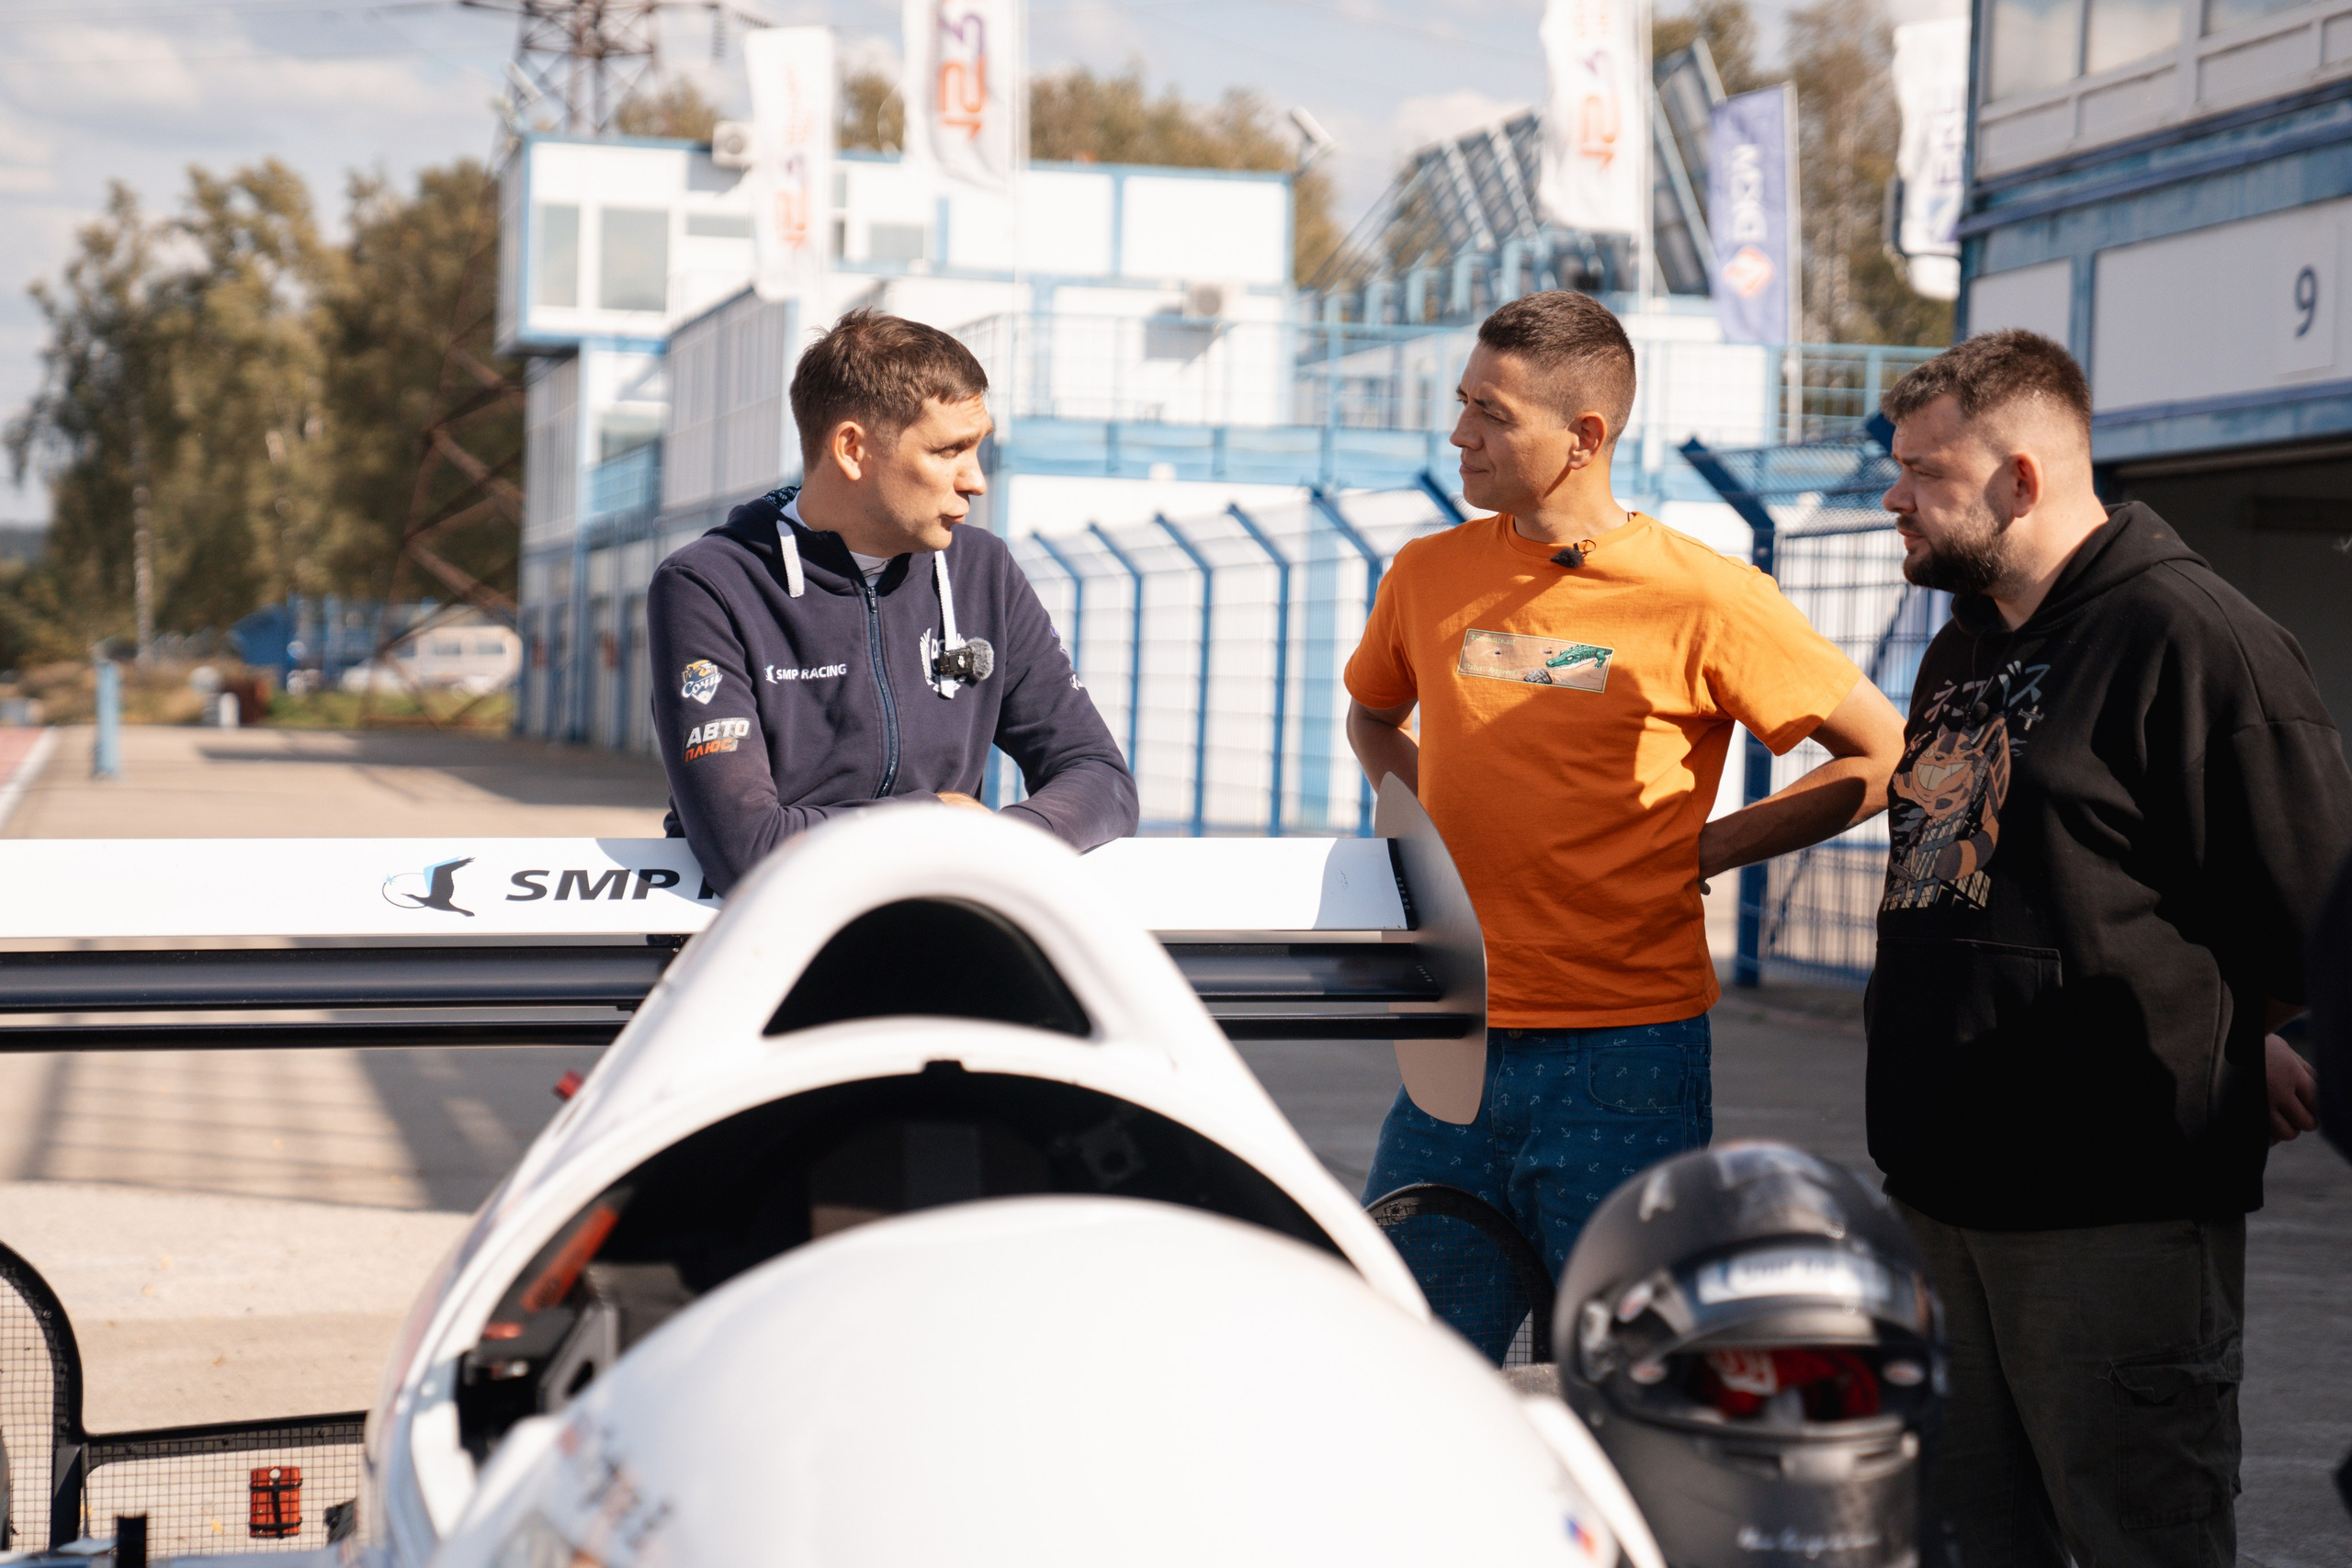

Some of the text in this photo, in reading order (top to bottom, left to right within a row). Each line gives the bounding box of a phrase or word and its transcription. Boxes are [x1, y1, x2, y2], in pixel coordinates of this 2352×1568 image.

[2294, 264, 2318, 338] 9
[776, 663, 847, 680] SMP RACING
[685, 720, 750, 749] АВТО
[685, 739, 732, 763] ПЛЮС
[505, 869, 680, 902] SMP
